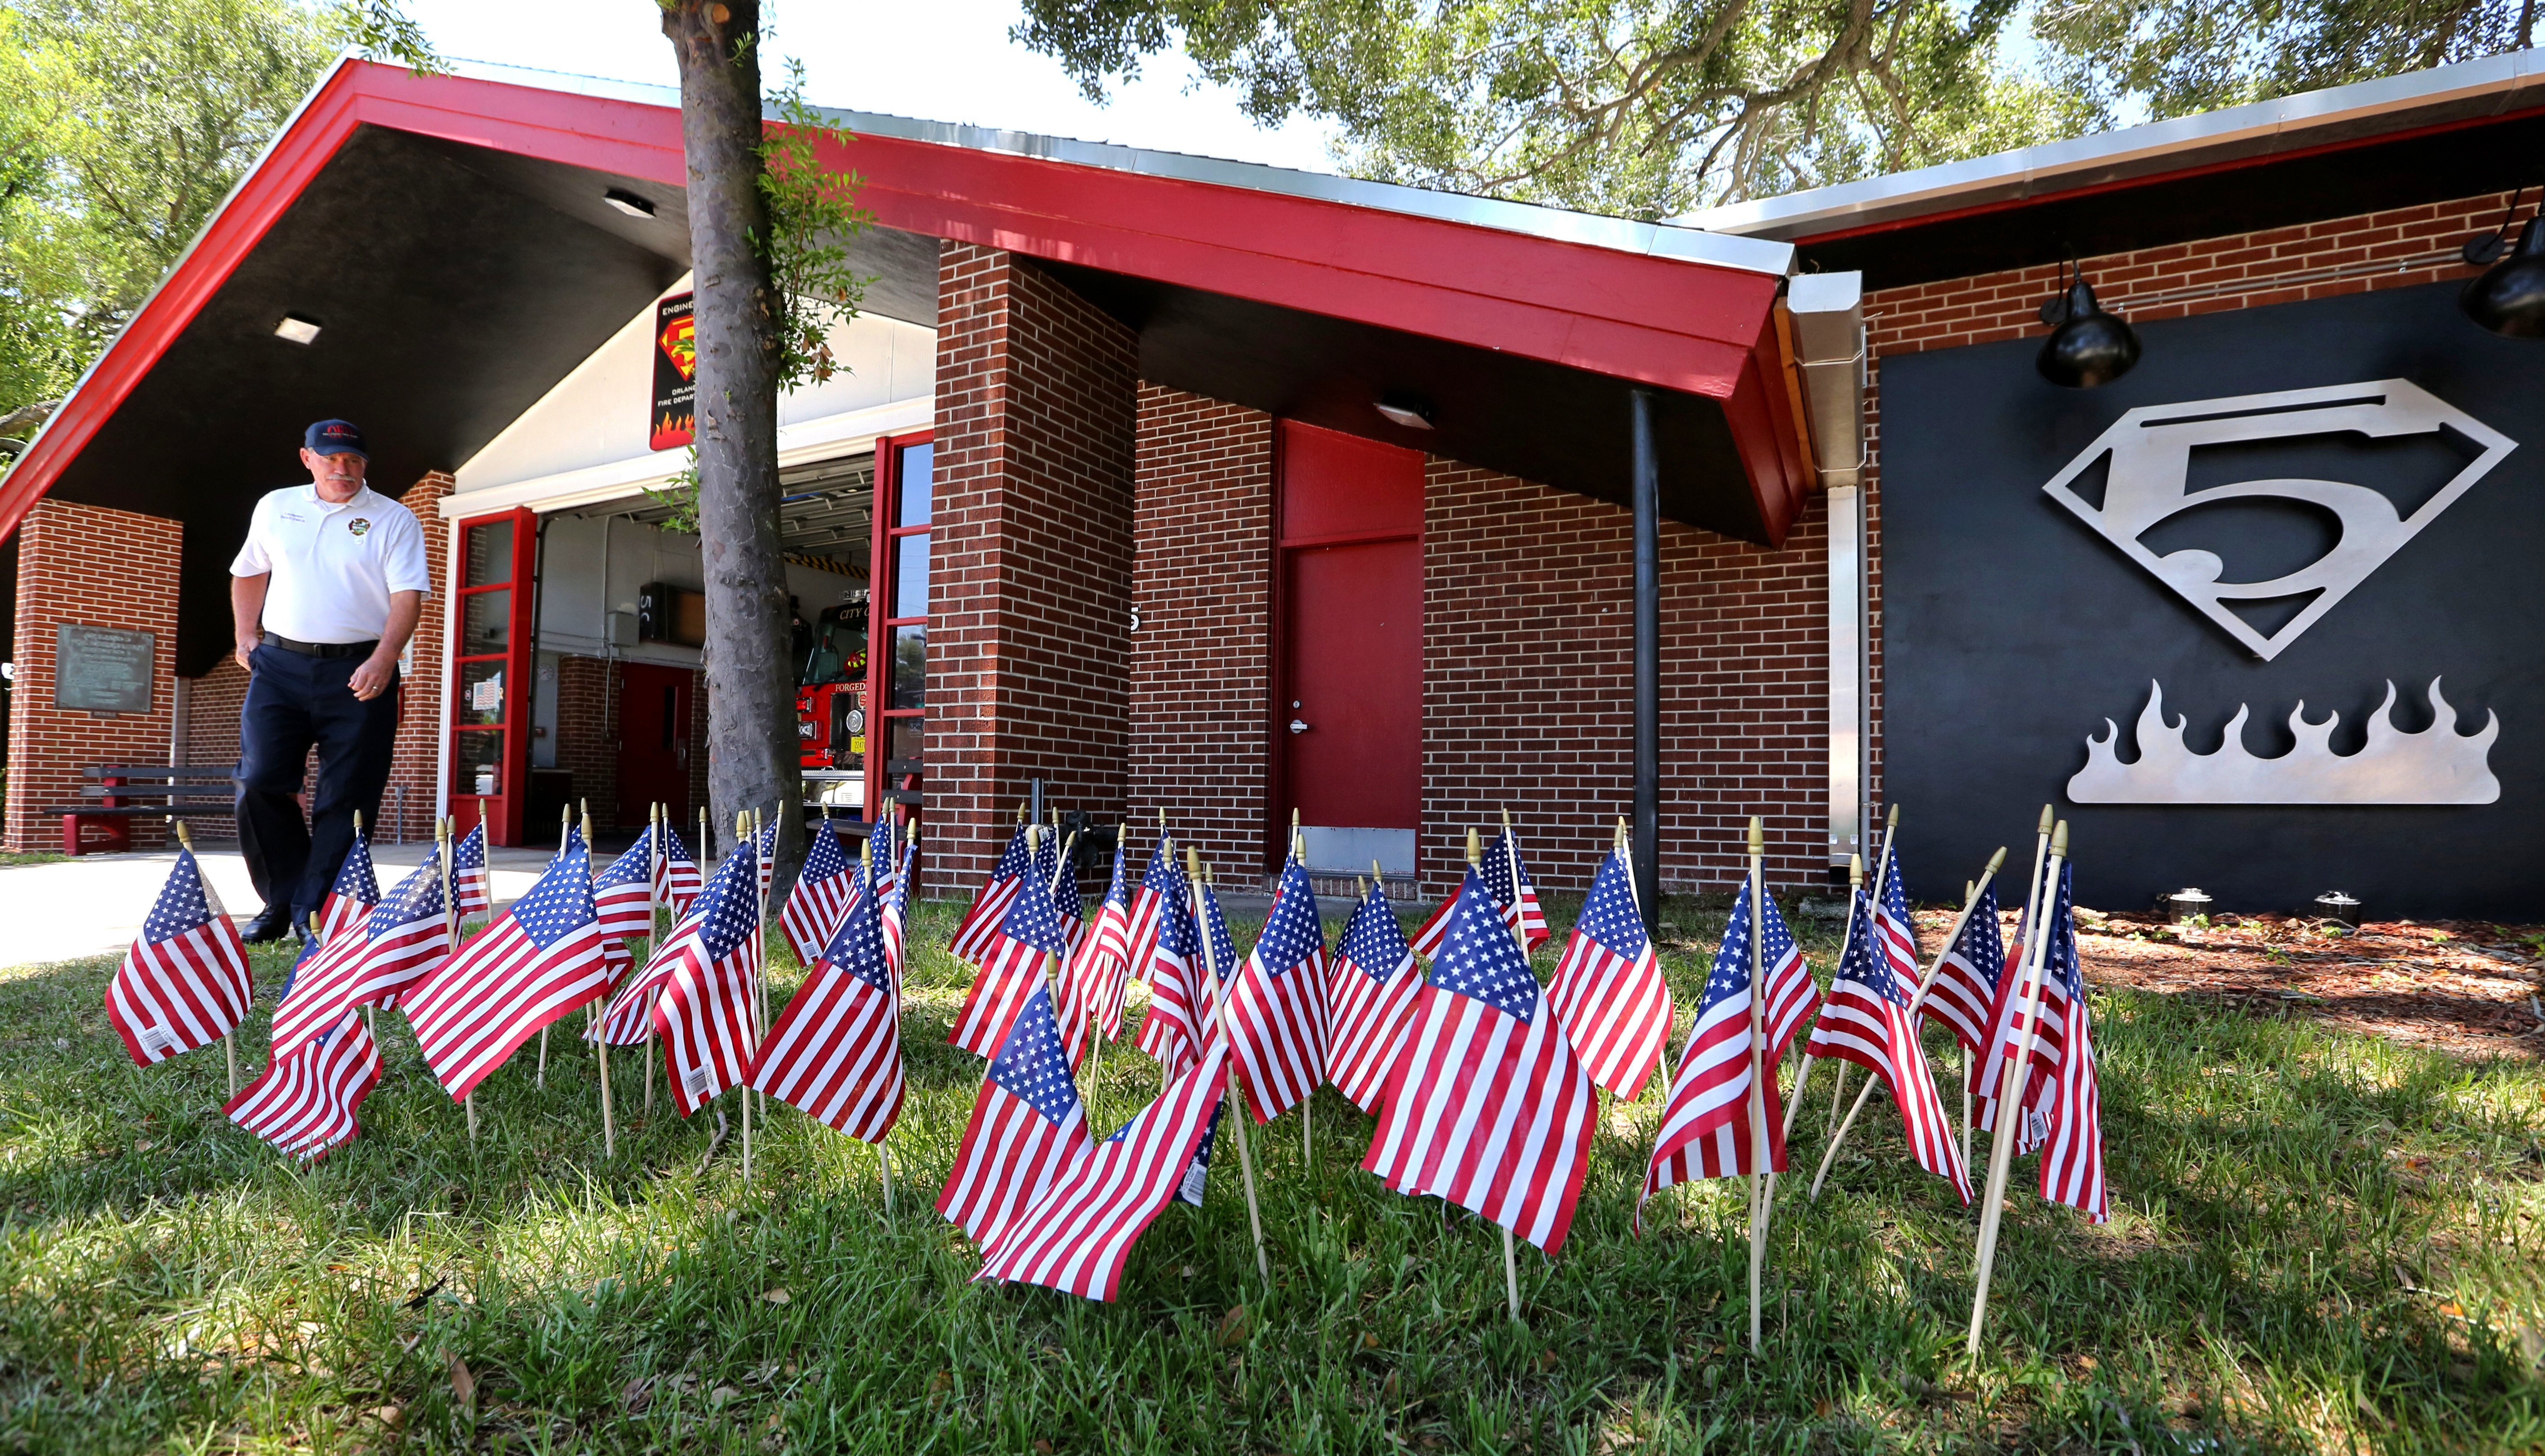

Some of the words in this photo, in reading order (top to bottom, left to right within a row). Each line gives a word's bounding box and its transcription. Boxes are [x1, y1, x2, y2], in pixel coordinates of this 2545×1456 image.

[662, 300, 693, 316] ENGINE
[672, 384, 696, 396] ORLAND
[658, 398, 672, 407] FIRE
[673, 393, 694, 404] DEPAR
[2103, 403, 2440, 599] 5
[840, 607, 862, 620] CITY
[835, 682, 866, 692] FORGED
